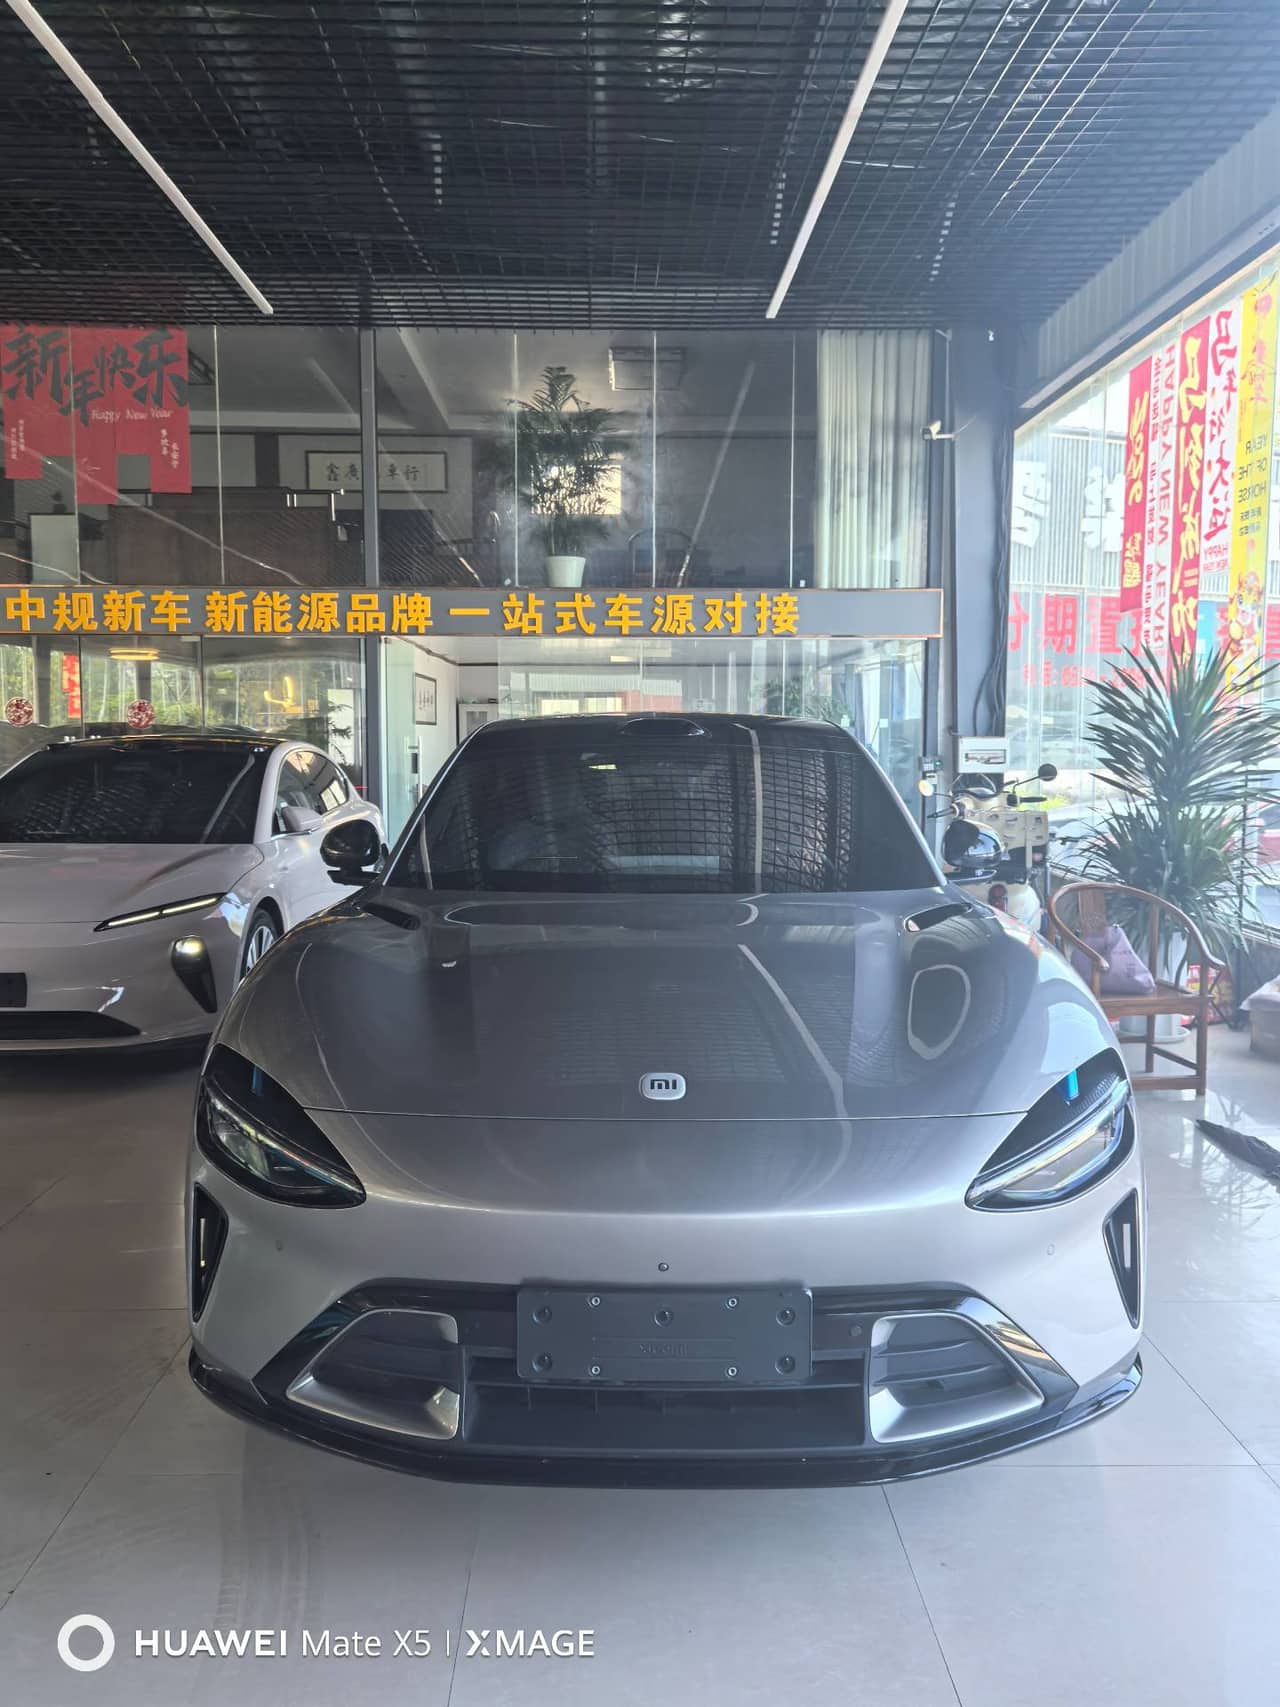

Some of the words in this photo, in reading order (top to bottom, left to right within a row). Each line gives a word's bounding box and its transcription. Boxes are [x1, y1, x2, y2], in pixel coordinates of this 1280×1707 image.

[3, 322, 188, 427] 新年快乐
[91, 408, 120, 424] Happy
[126, 409, 147, 421] New
[151, 408, 173, 420] Year
[5, 589, 191, 633] 中规新车
[205, 590, 434, 633] 新能源品牌
[449, 591, 801, 635] 一站式车源对接
